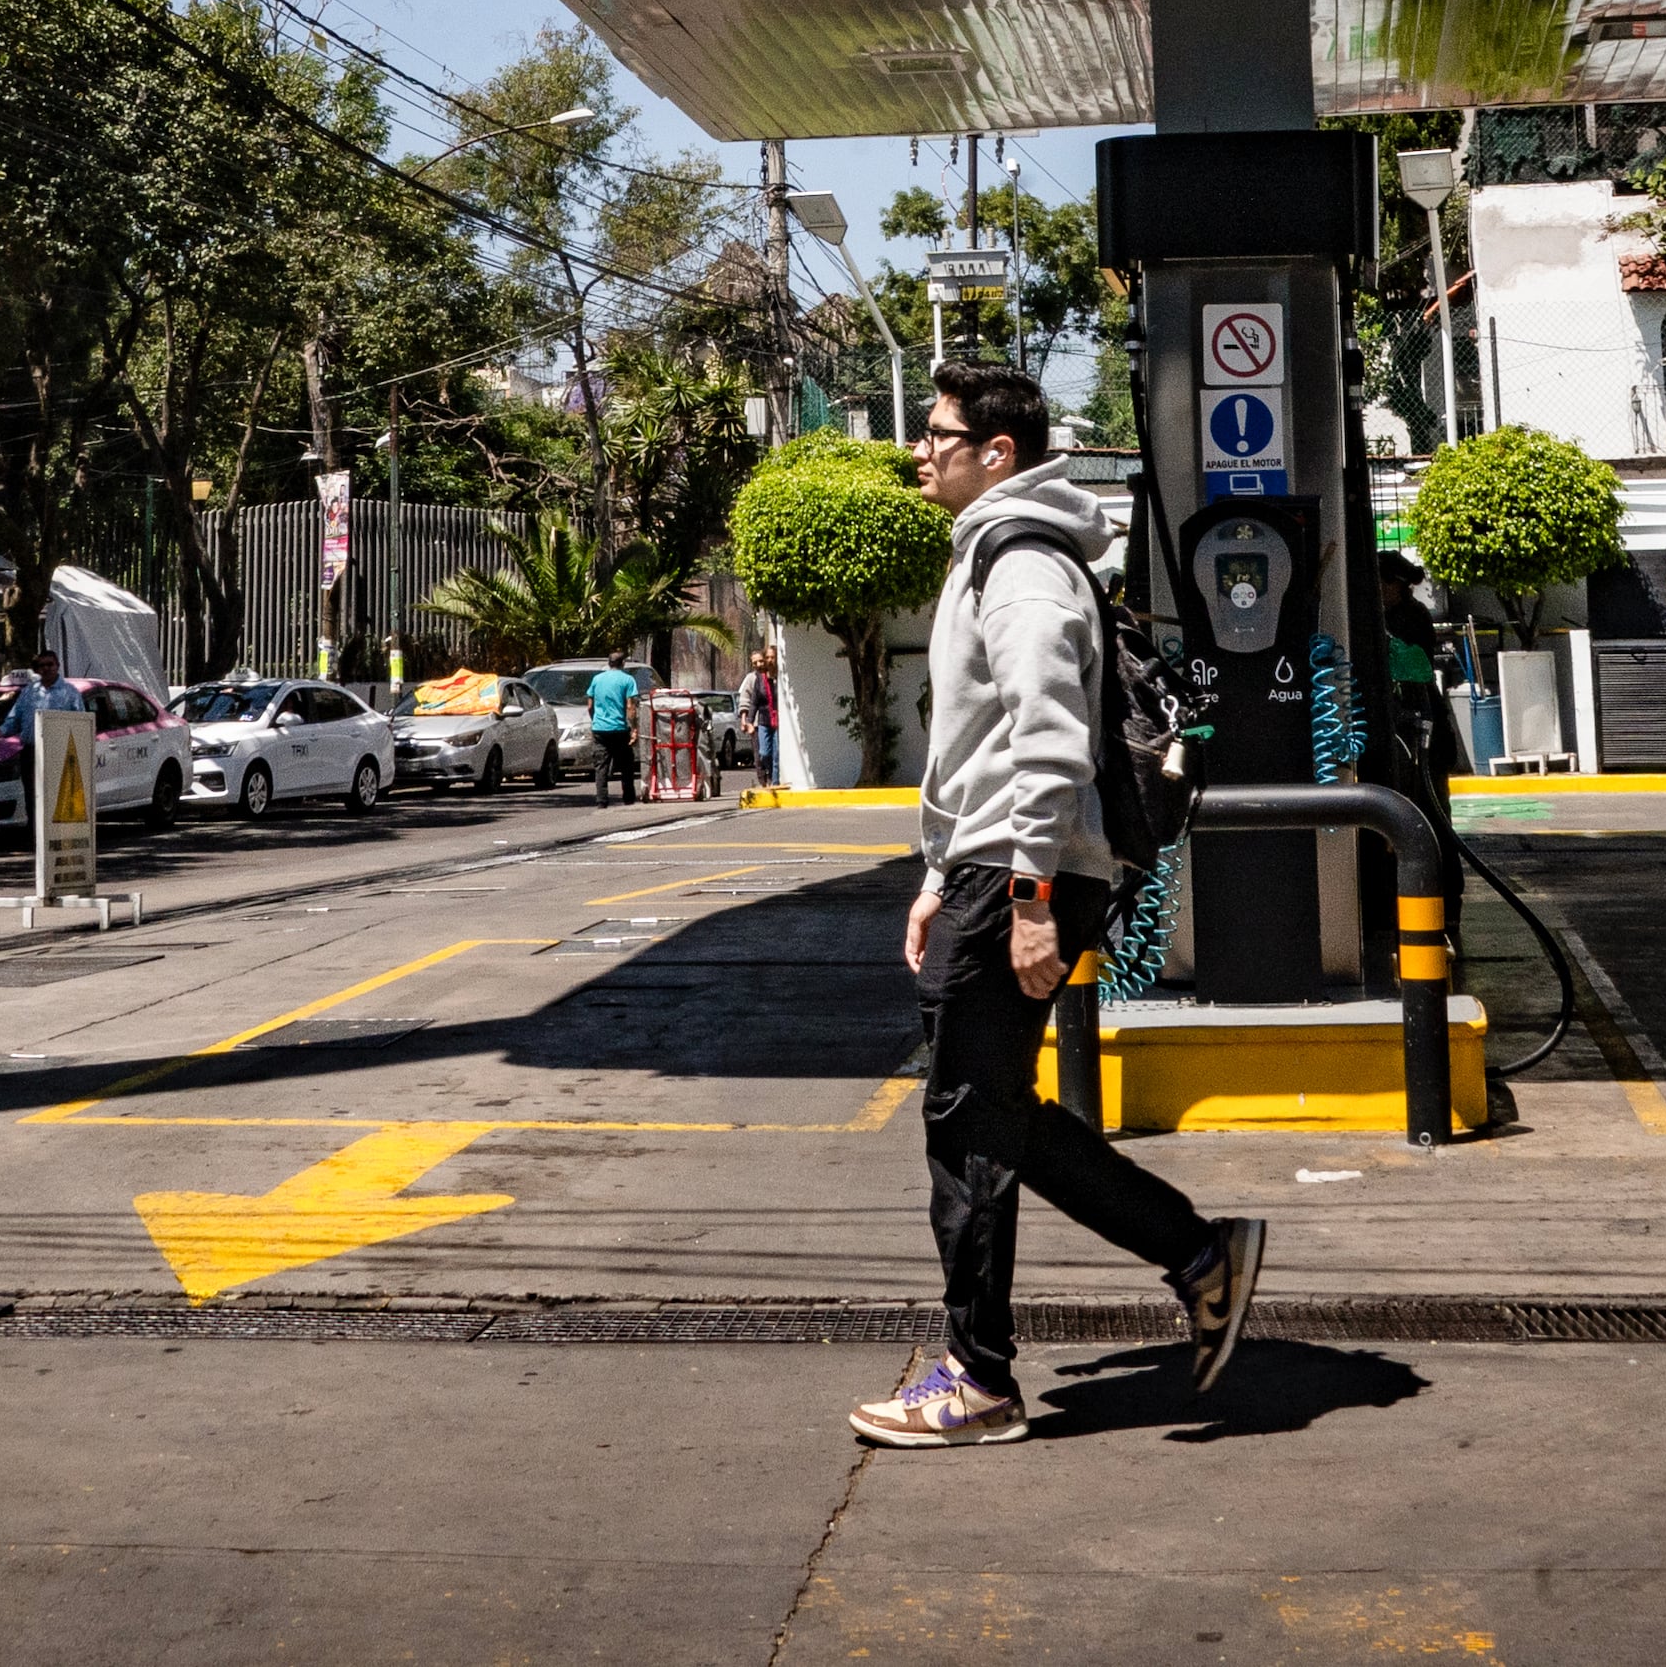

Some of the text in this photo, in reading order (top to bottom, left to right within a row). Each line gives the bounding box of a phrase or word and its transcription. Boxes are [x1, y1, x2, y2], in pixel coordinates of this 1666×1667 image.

[1205, 458, 1282, 469] APAGUE EL MOTOR
[1268, 689, 1303, 703] Agua
[291, 744, 309, 757] TAXI
